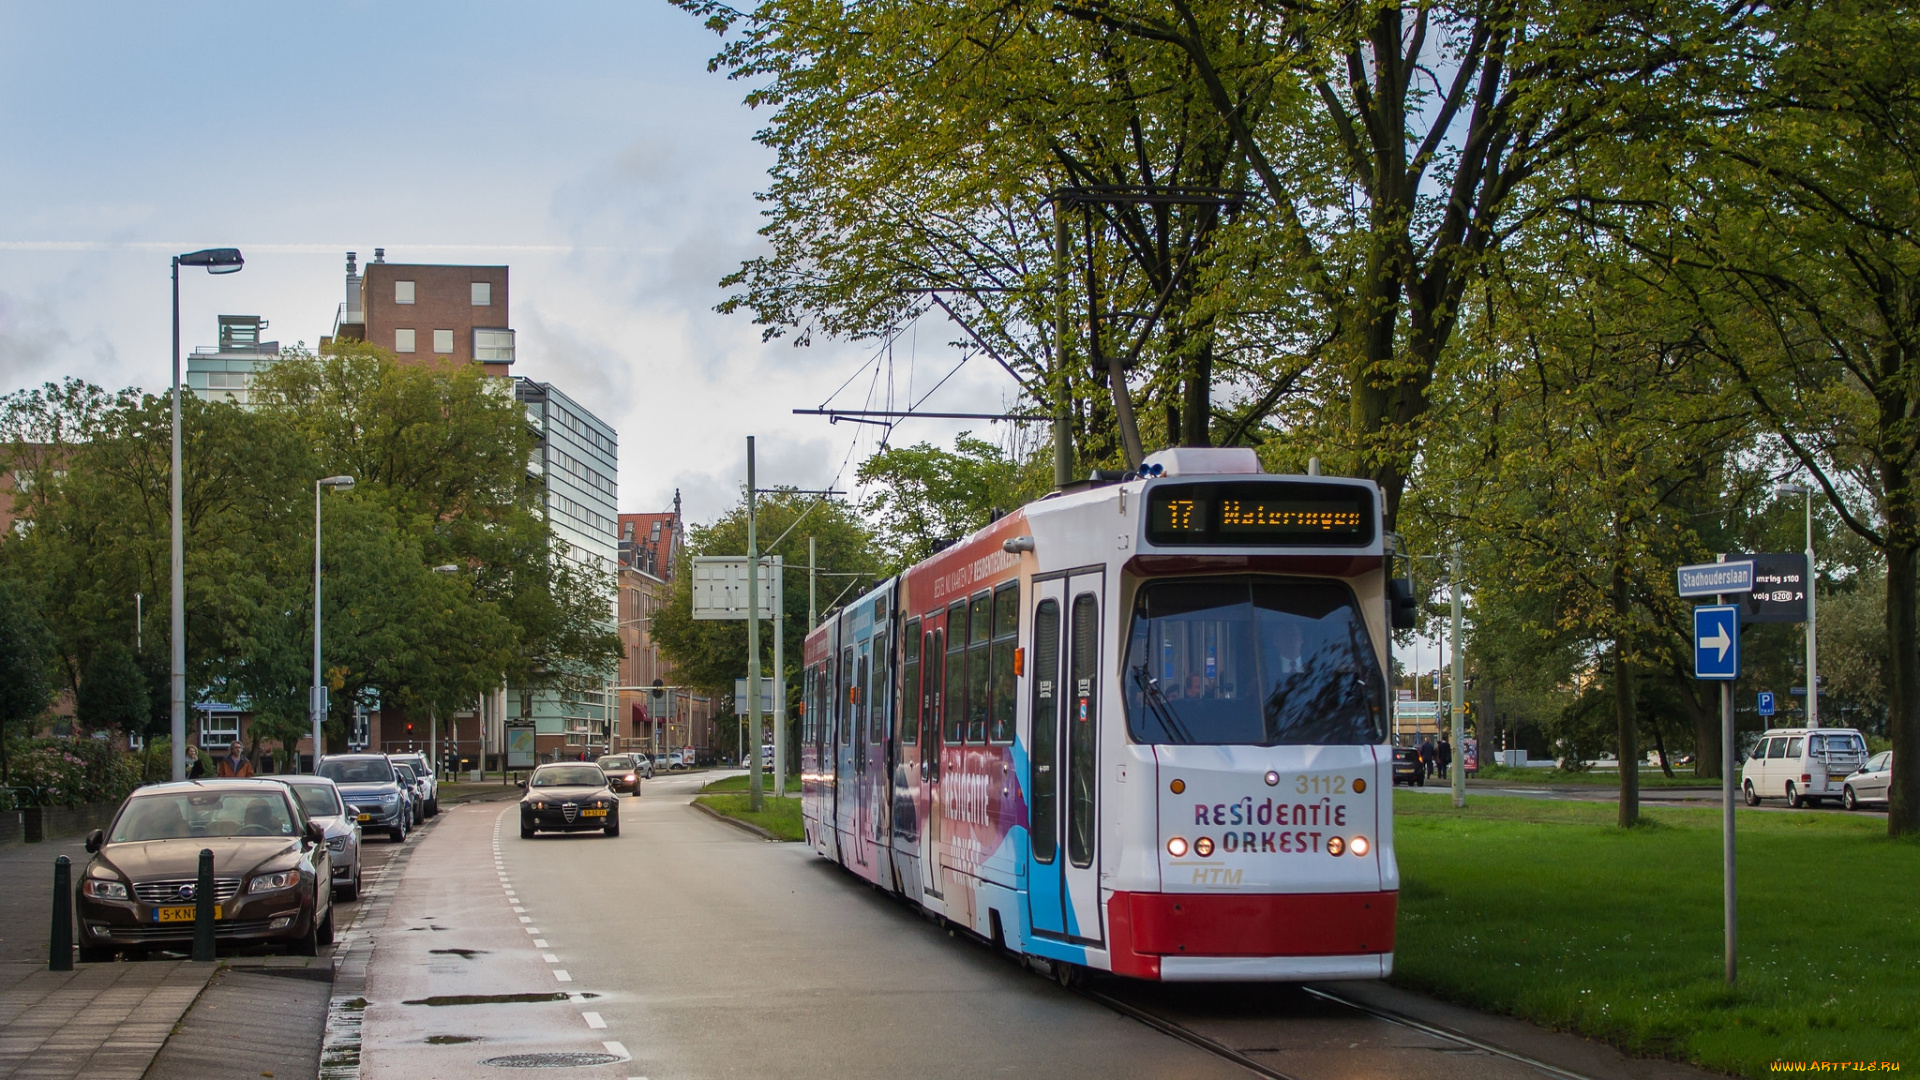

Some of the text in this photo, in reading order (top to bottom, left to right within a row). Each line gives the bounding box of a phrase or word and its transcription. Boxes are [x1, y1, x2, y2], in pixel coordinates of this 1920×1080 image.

[1167, 500, 1360, 530] 17 Wateringen
[1683, 569, 1748, 588] Stadhouderslaan
[1783, 575, 1799, 583] s100
[1752, 591, 1792, 601] volg s200
[1761, 694, 1771, 706] P
[1295, 774, 1347, 795] 3112
[1222, 831, 1322, 854] ORKEST
[1191, 867, 1244, 886] HTM
